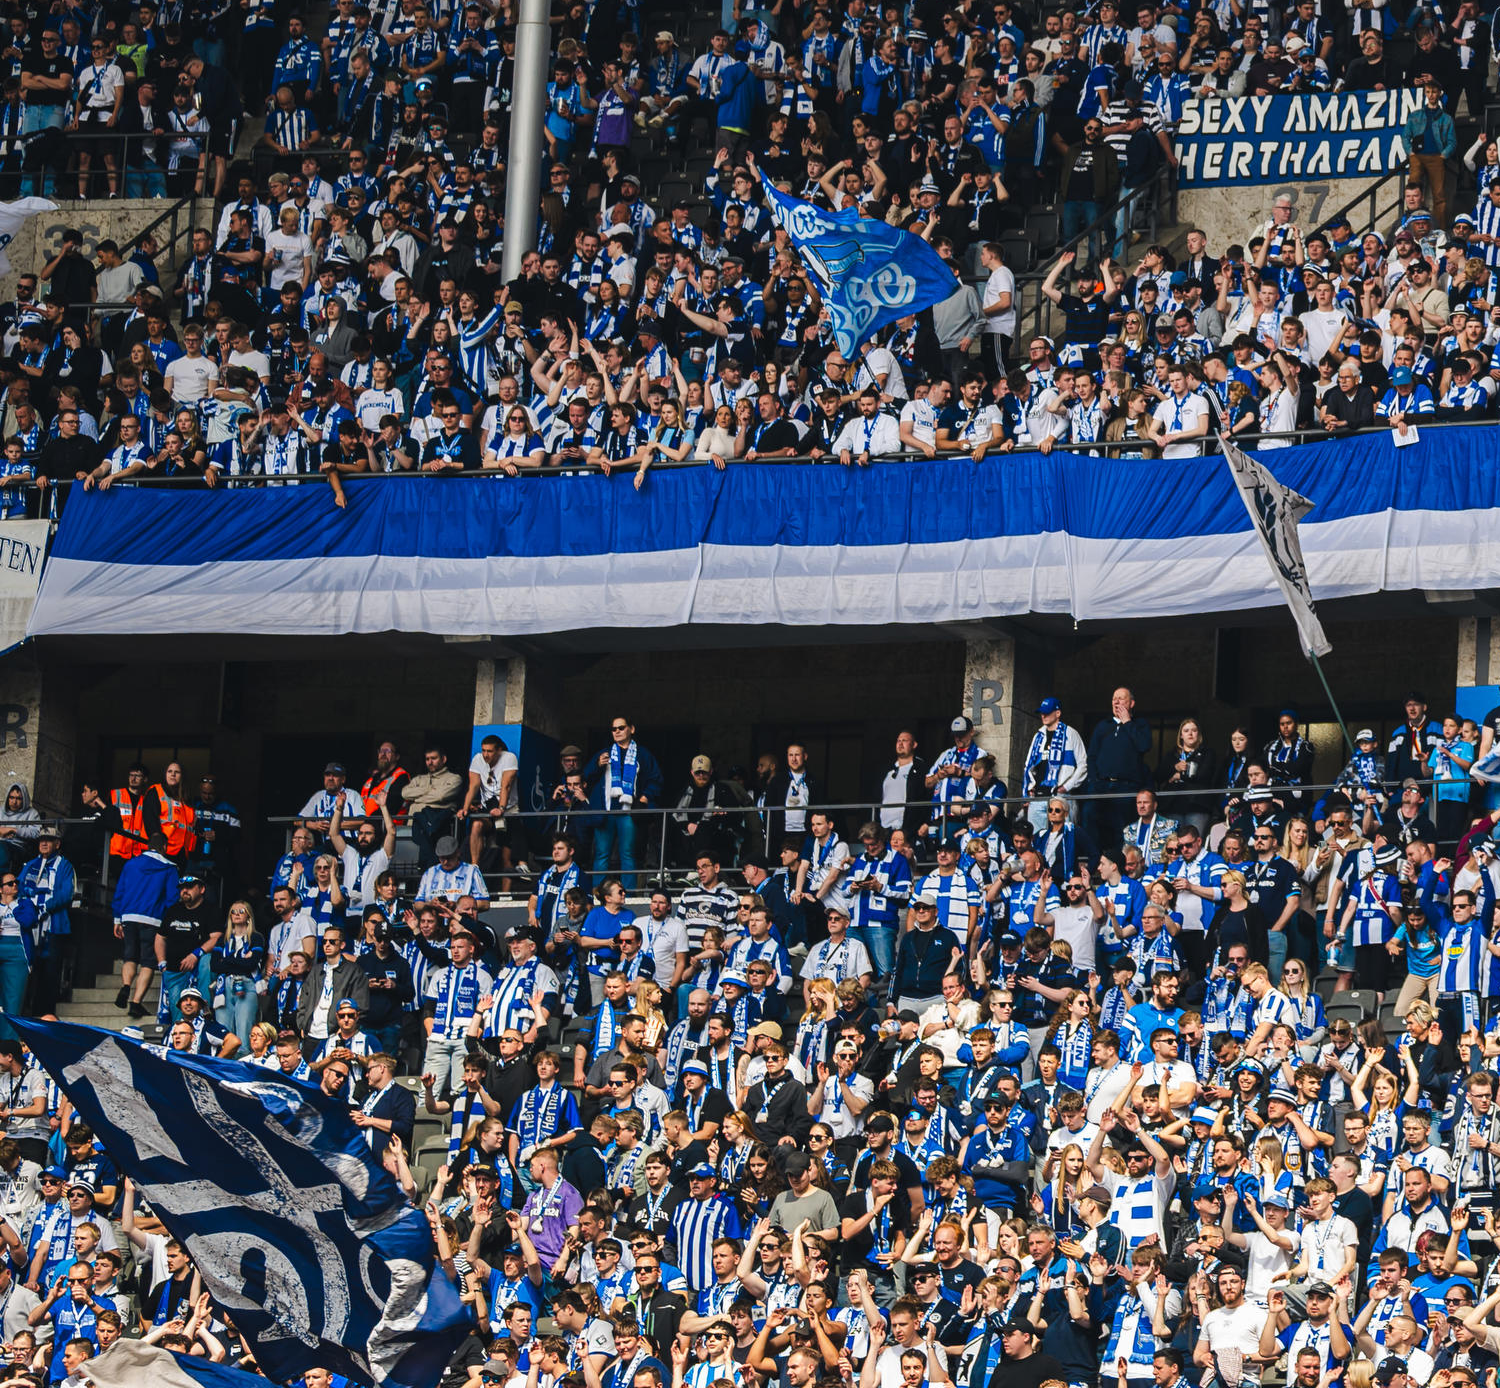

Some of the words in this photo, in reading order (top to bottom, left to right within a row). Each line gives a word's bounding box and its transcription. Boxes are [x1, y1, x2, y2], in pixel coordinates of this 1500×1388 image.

[1178, 94, 1273, 134] SEXY
[1283, 87, 1434, 132] AMAZIN
[971, 678, 1004, 726] R
[0, 704, 29, 749] R
